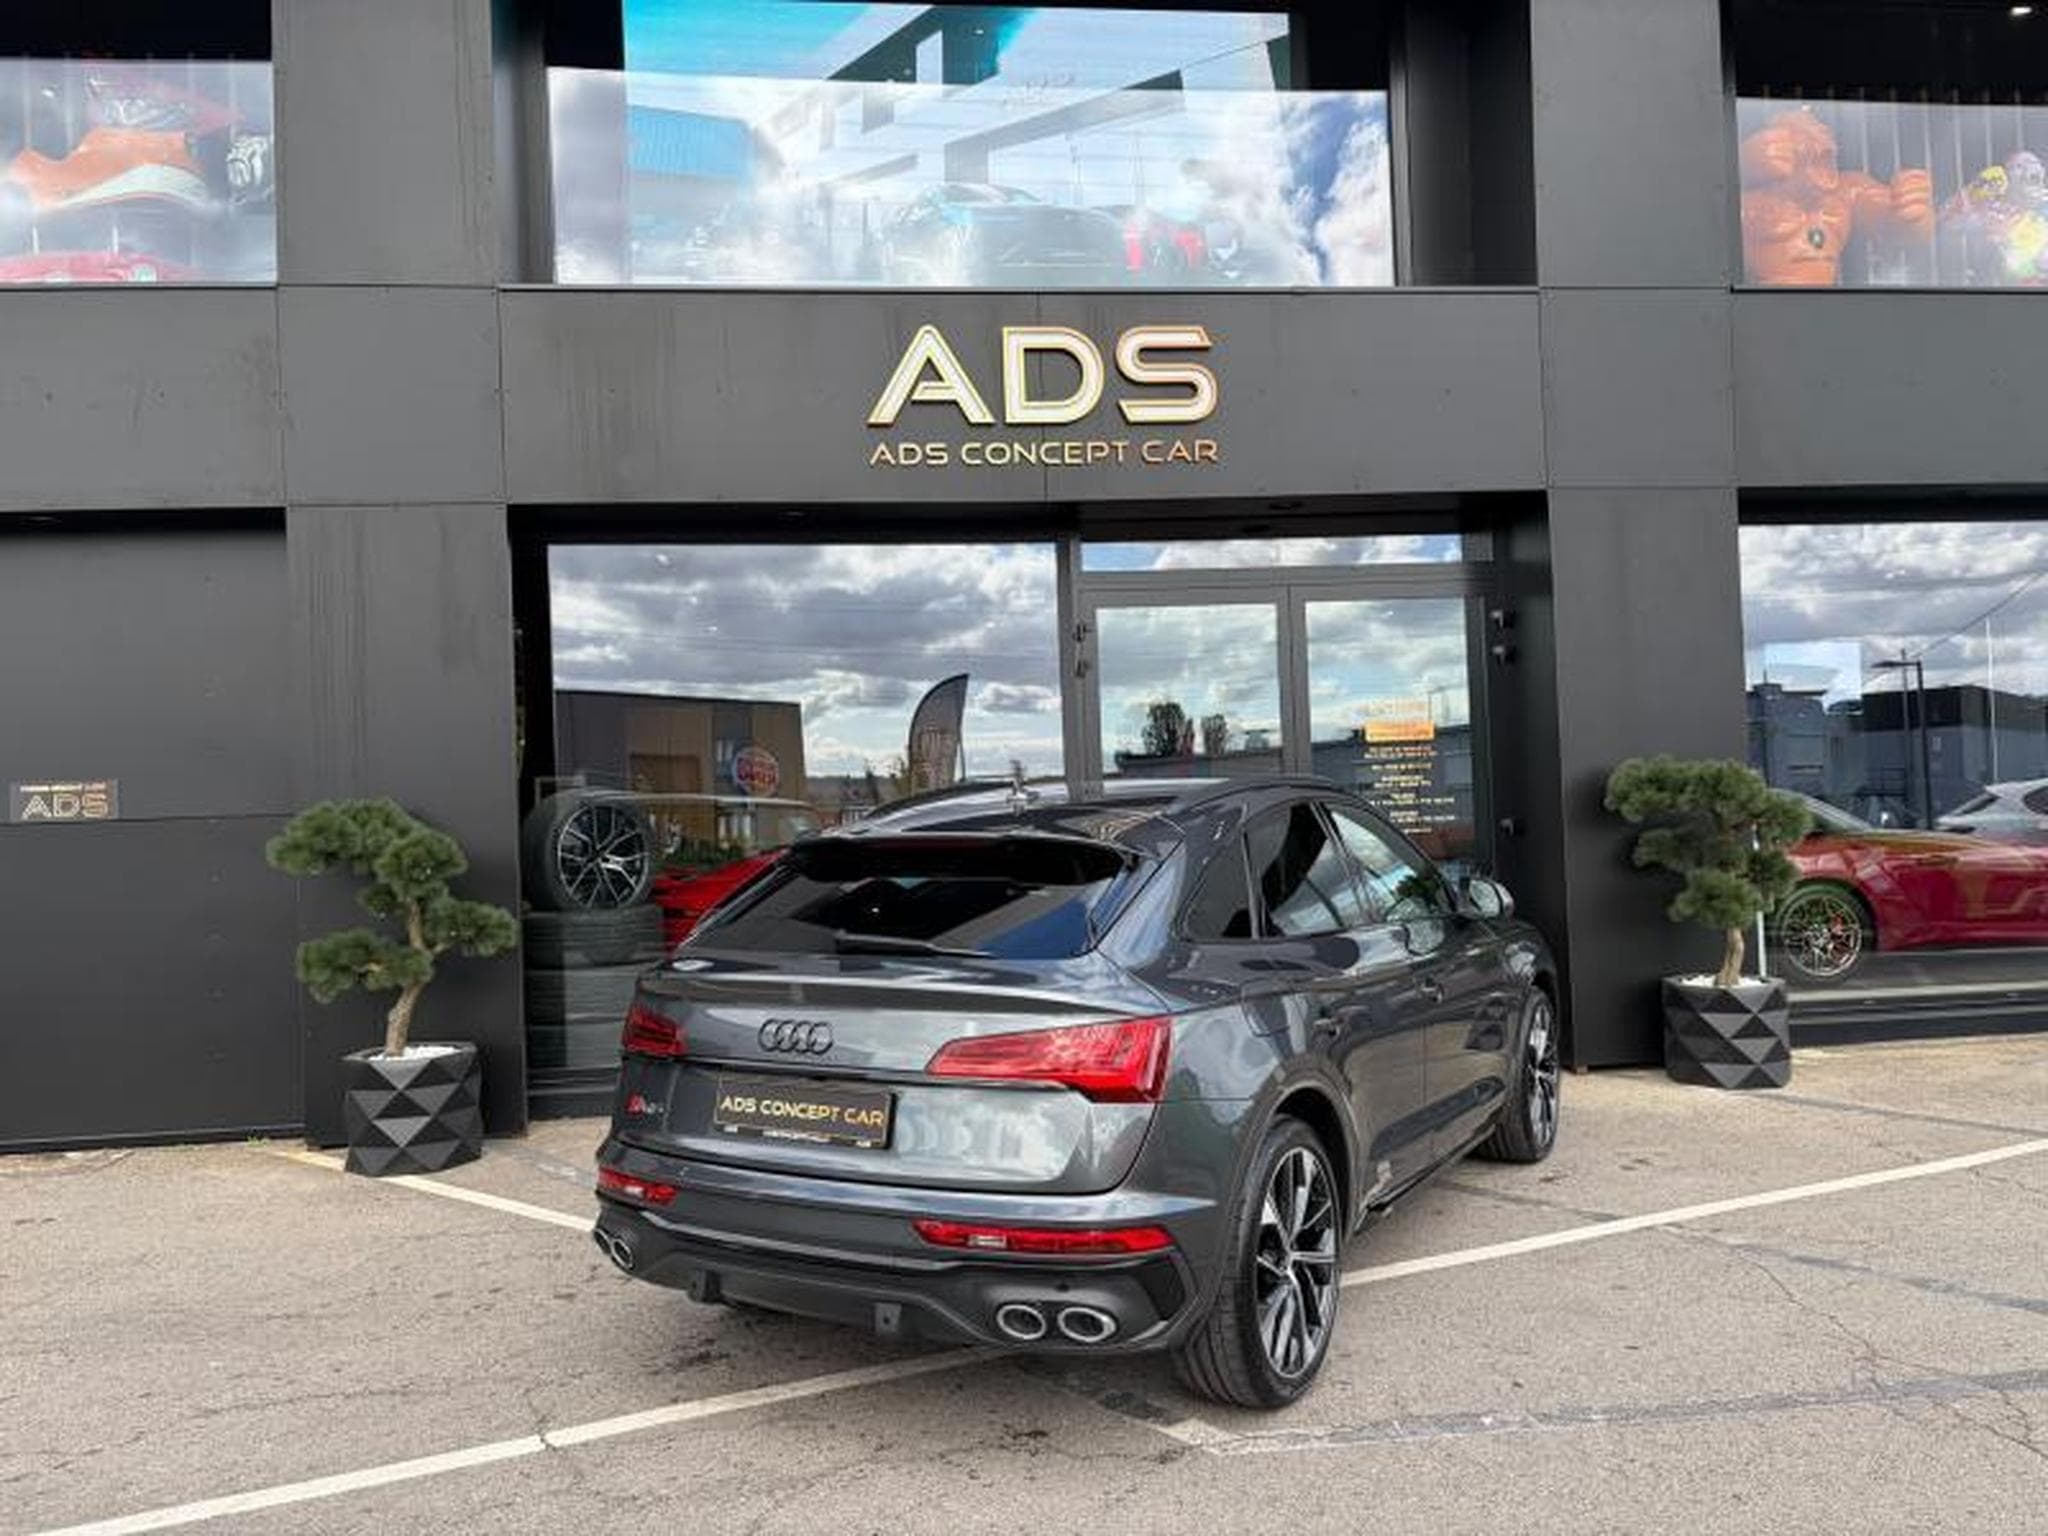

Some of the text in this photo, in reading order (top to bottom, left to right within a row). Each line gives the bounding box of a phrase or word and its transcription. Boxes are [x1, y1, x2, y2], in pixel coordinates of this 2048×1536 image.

[867, 324, 1219, 425] ADS
[869, 439, 1219, 466] ADS CONCEPT CAR
[21, 793, 108, 820] ADS
[720, 1095, 884, 1126] ADS CONCEPT CAR
